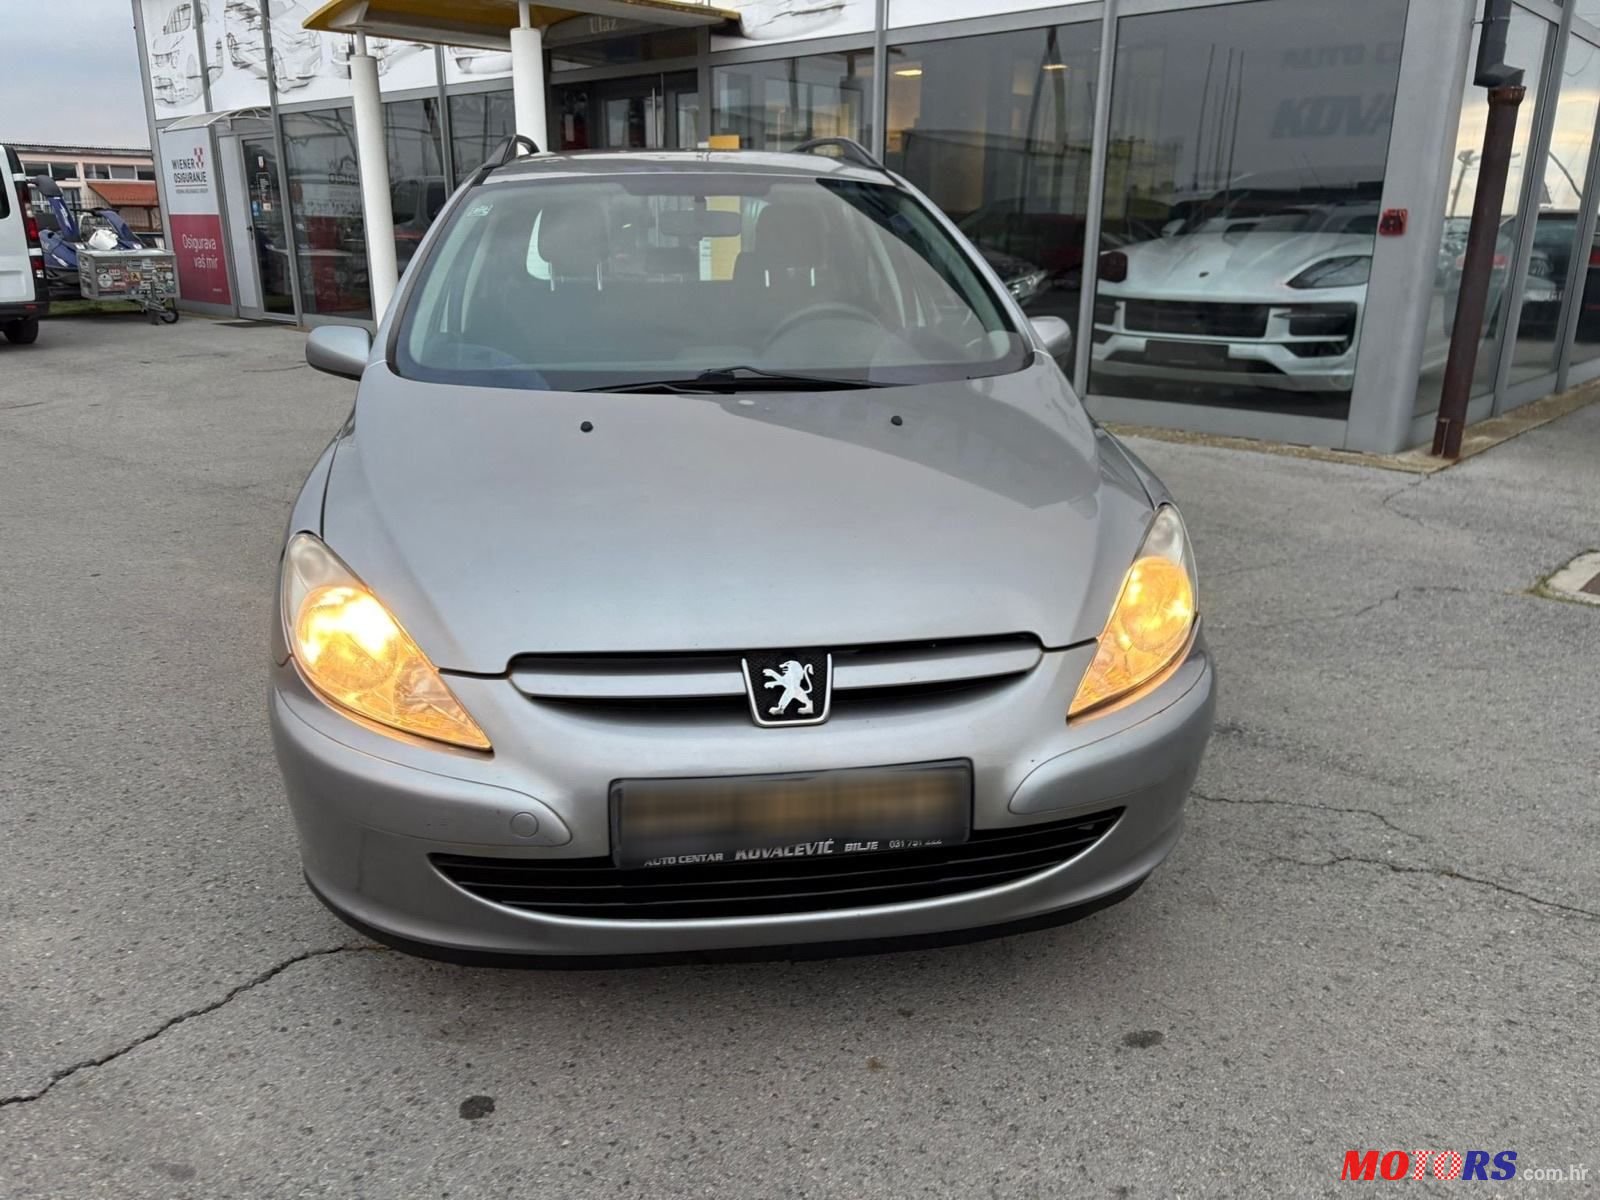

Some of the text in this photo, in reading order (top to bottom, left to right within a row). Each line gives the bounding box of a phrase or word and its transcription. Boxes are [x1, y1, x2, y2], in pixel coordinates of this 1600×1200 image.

[171, 158, 195, 169] WIENER
[174, 171, 207, 183] OSIGURANJE
[182, 233, 217, 253] Osigurava
[193, 254, 218, 269] vaš mir
[644, 856, 676, 867] AUTO
[678, 853, 724, 864] CENTAR
[844, 841, 879, 852] BILJE
